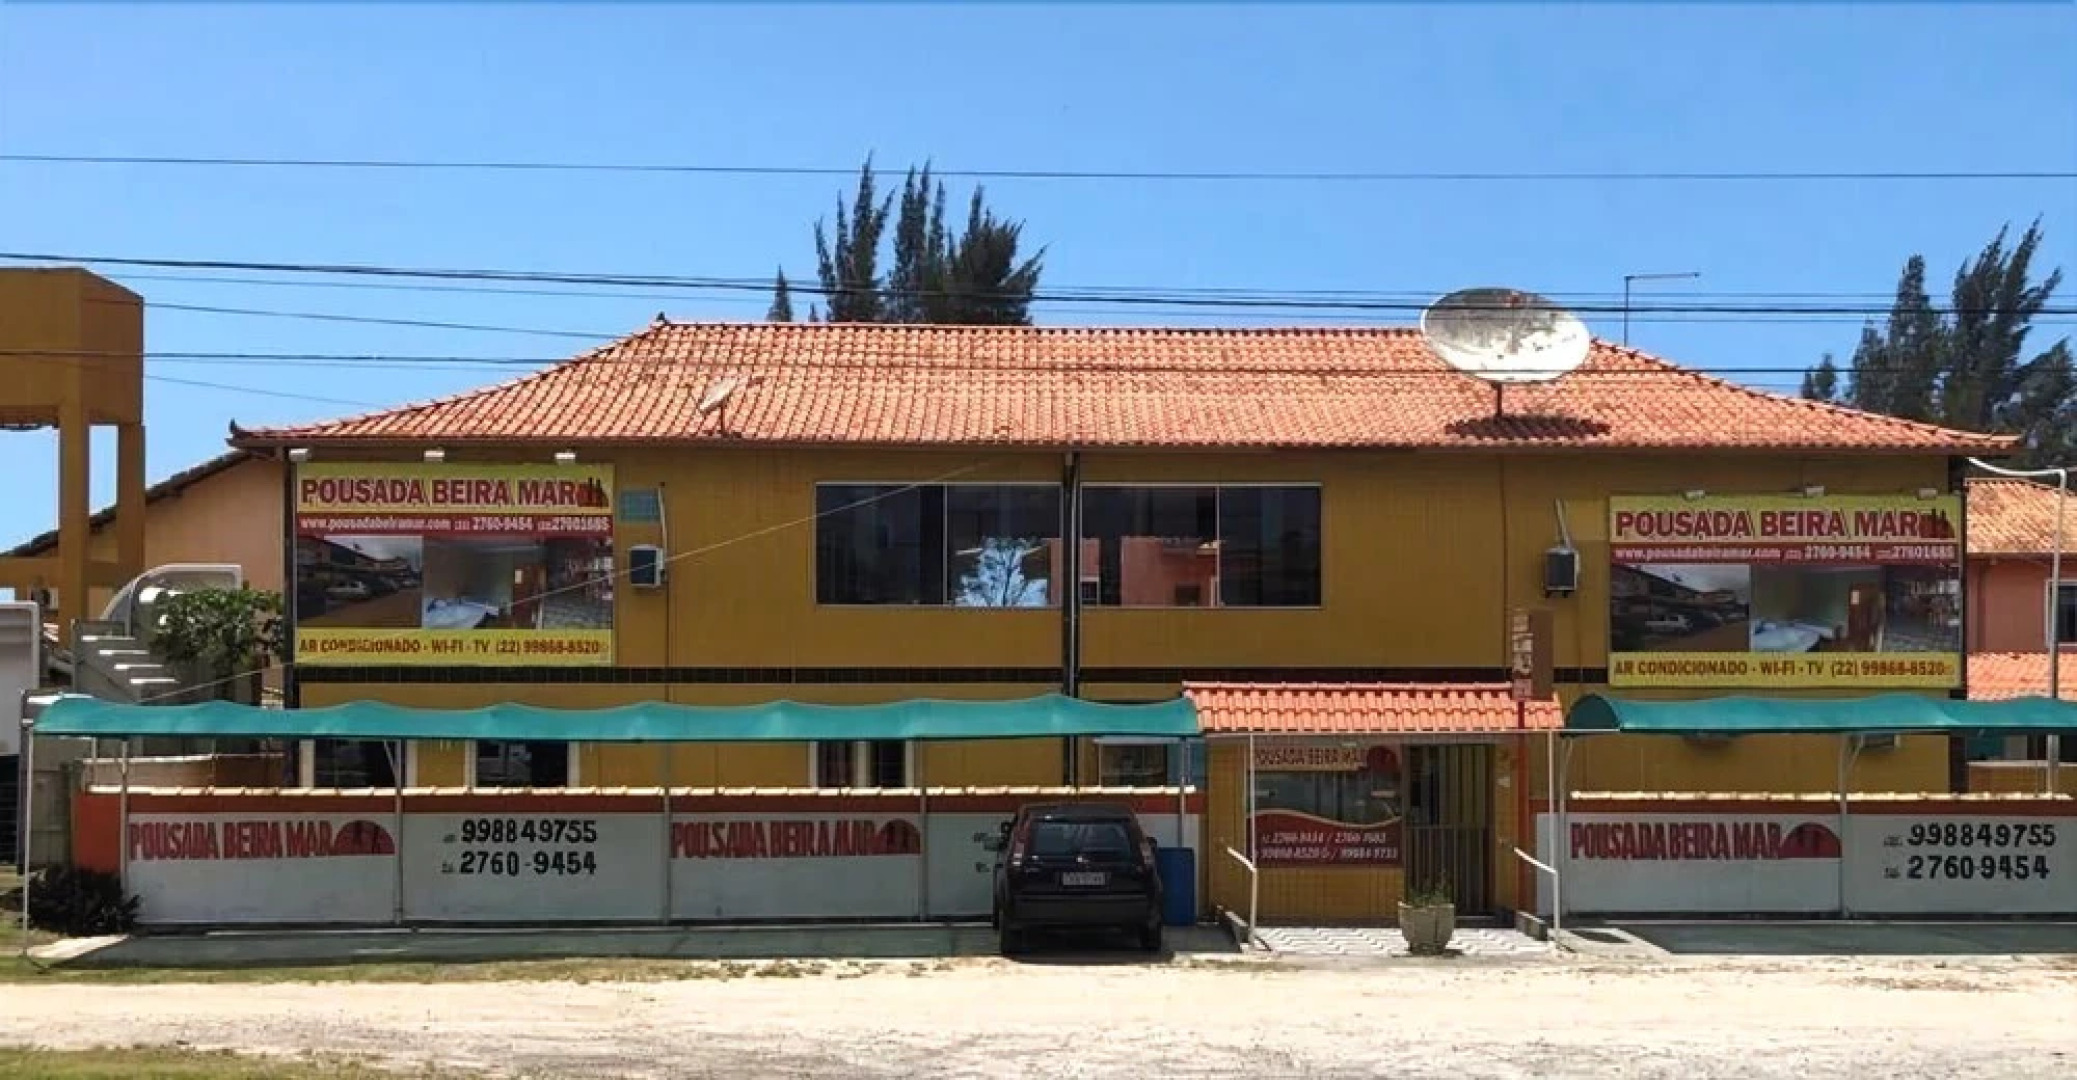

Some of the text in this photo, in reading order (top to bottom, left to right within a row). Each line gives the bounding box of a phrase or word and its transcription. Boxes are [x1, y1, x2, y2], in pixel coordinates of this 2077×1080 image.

[301, 478, 577, 506] POUSADA BEIRA MAR
[1614, 509, 1917, 537] POUSADA BEIRA MAR
[299, 639, 317, 652] AR
[320, 639, 420, 653] CONDICIONADO
[431, 639, 462, 653] WI-FI
[474, 639, 488, 653] TV
[496, 639, 520, 655] (22)
[1615, 660, 1632, 674] AR
[1637, 660, 1747, 674] CONDICIONADO
[1760, 660, 1795, 674] WI-FI
[1807, 660, 1823, 674] TV
[1831, 660, 1857, 676] (22)
[128, 821, 333, 861] POUSADA BEIRA MAR
[461, 818, 598, 843] 998849755
[671, 821, 767, 859] POUSADA
[770, 820, 829, 857] BEIRA
[1571, 823, 1782, 860] POUSADA BEIRA MAR
[1905, 822, 2057, 847] 998849755
[459, 850, 597, 876] 2760-9454
[1905, 854, 2050, 878] 2760-9454
